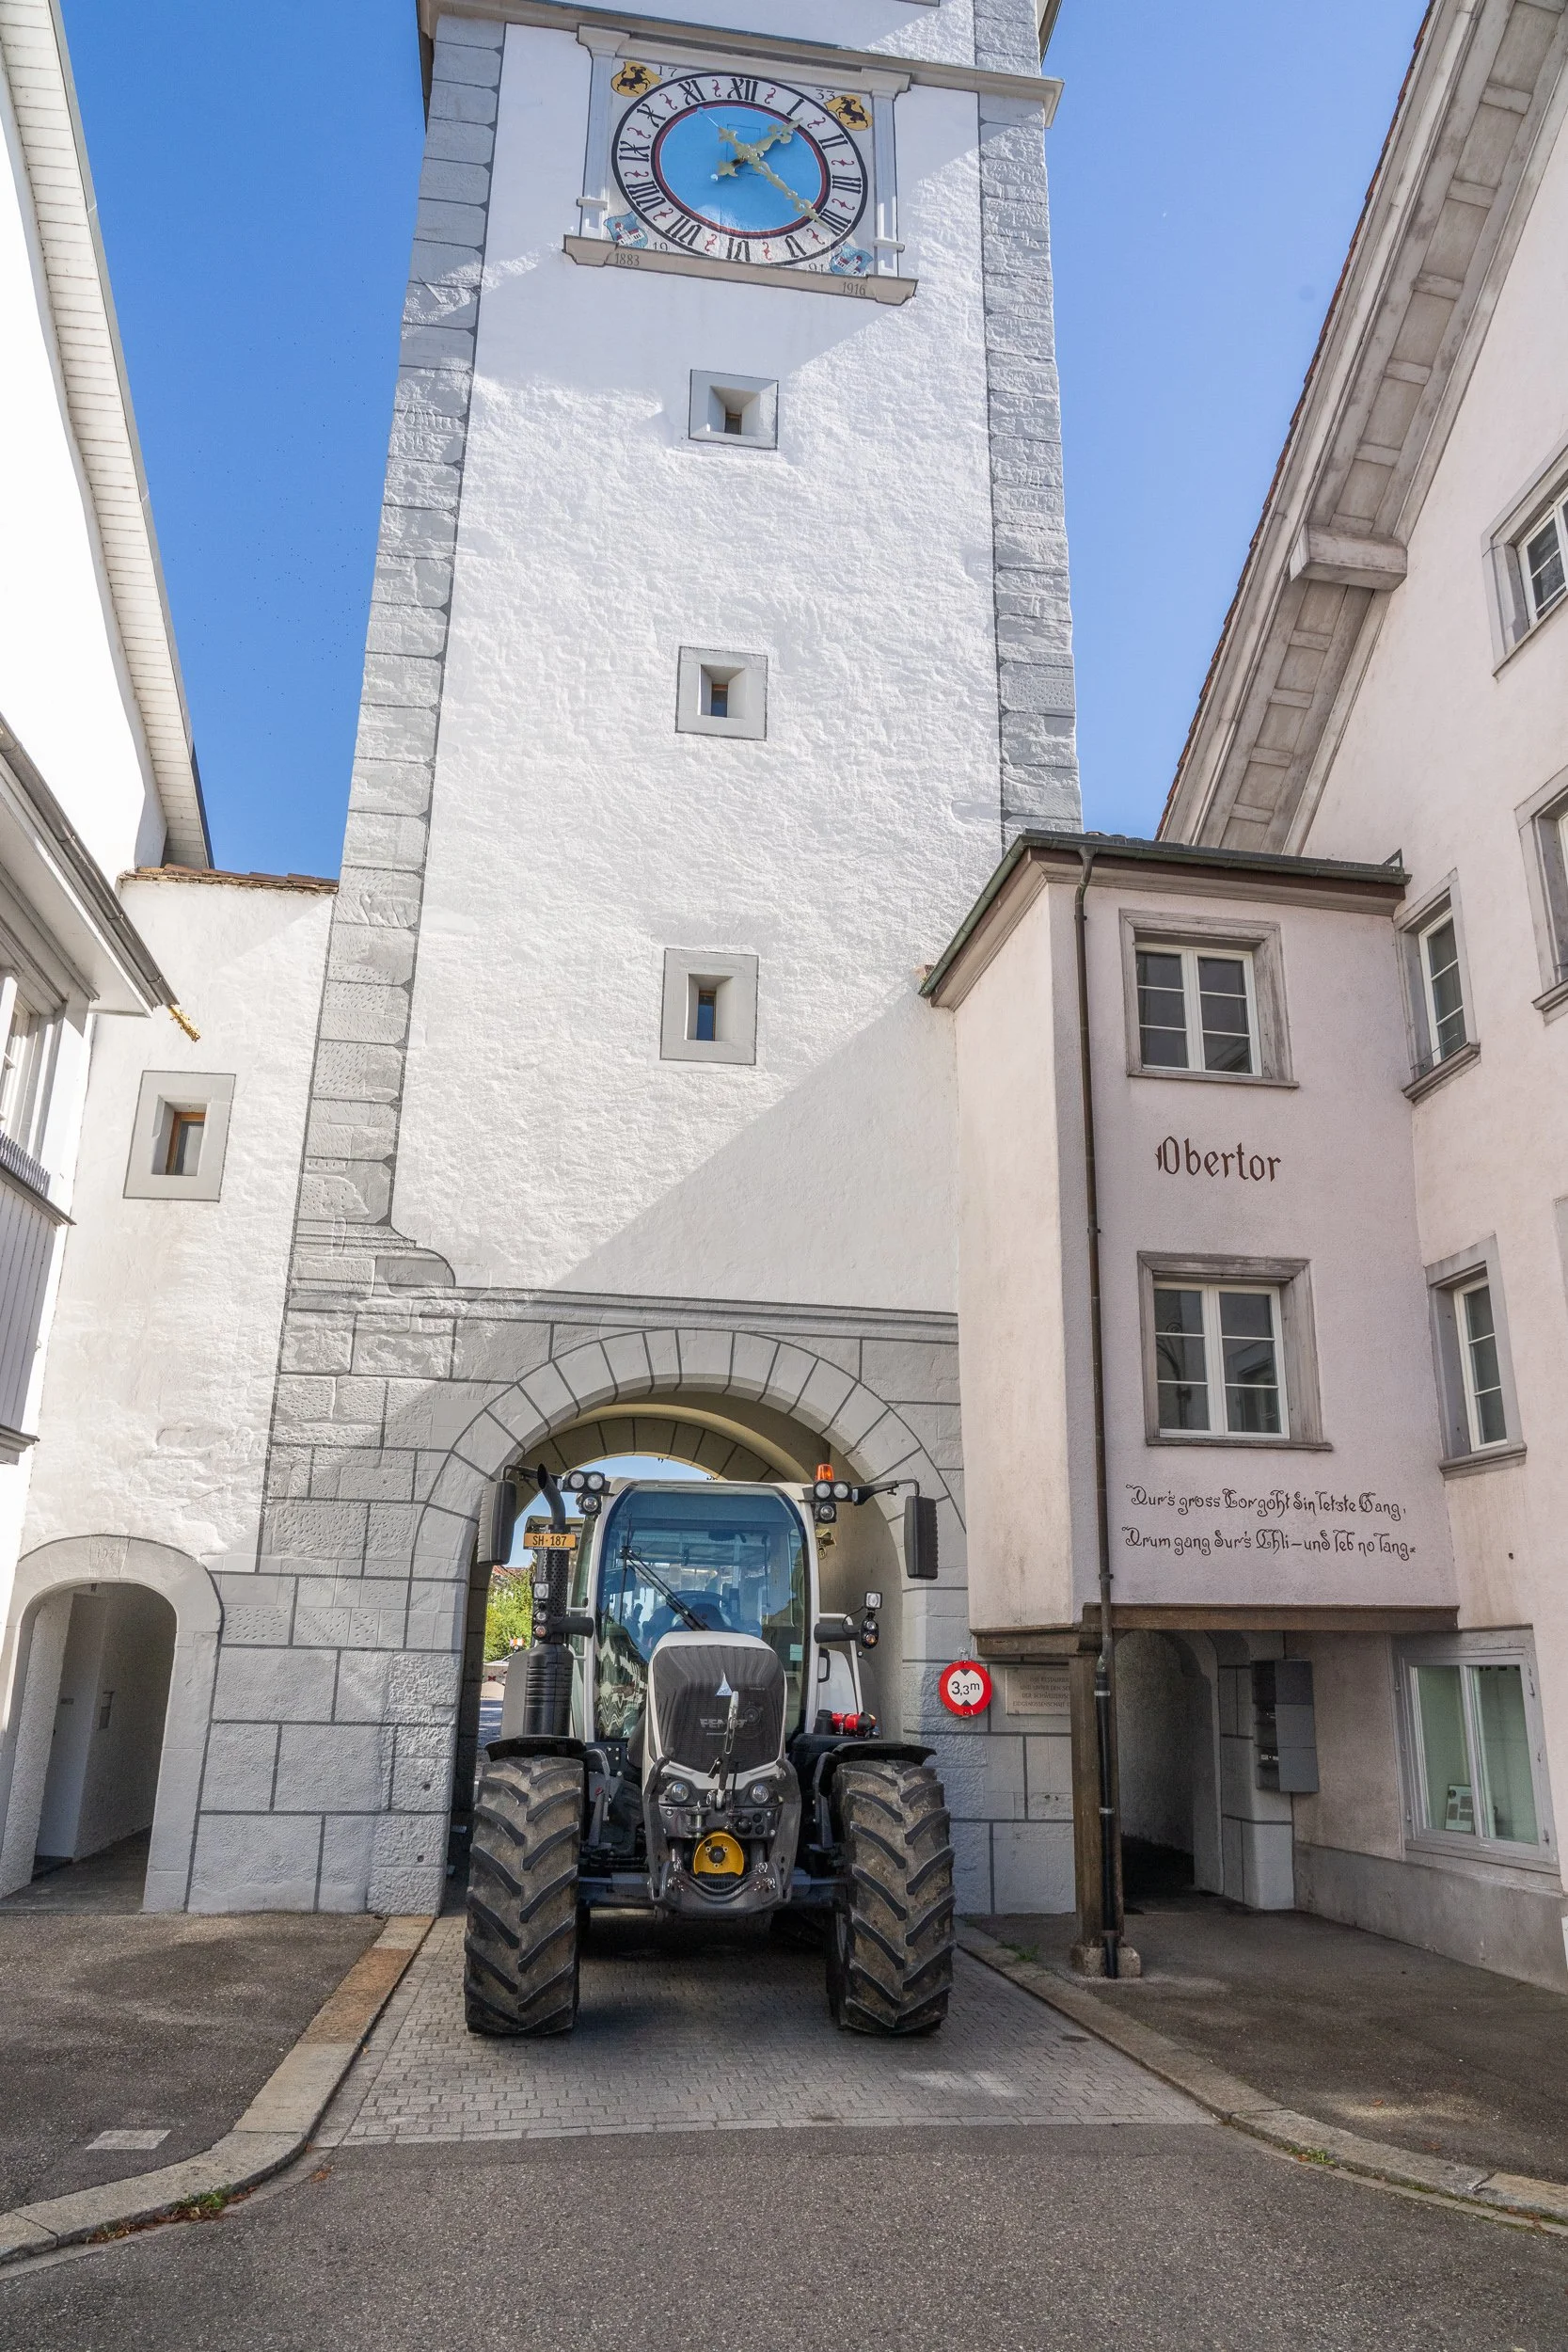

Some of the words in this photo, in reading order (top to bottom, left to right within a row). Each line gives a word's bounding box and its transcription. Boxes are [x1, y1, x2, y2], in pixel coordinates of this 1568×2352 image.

[658, 65, 678, 78] 17
[677, 79, 707, 106] XI
[727, 78, 759, 103] XII
[815, 88, 835, 100] 33
[636, 103, 667, 129] X
[618, 140, 652, 163] IX
[817, 133, 848, 151] II
[832, 174, 863, 195] III
[625, 180, 667, 214] VIII
[664, 215, 703, 246] VII
[614, 252, 640, 266] 1883
[725, 237, 751, 262] VI
[842, 281, 866, 296] 1916
[1154, 1136, 1282, 1183] Obertor
[1177, 1495, 1221, 1516] gross
[532, 1534, 545, 1546] SH
[550, 1535, 567, 1547] 187
[1121, 1526, 1171, 1549] Drum
[1174, 1536, 1212, 1556] gang
[1357, 1541, 1375, 1558] no
[700, 1719, 748, 1728] FENT
